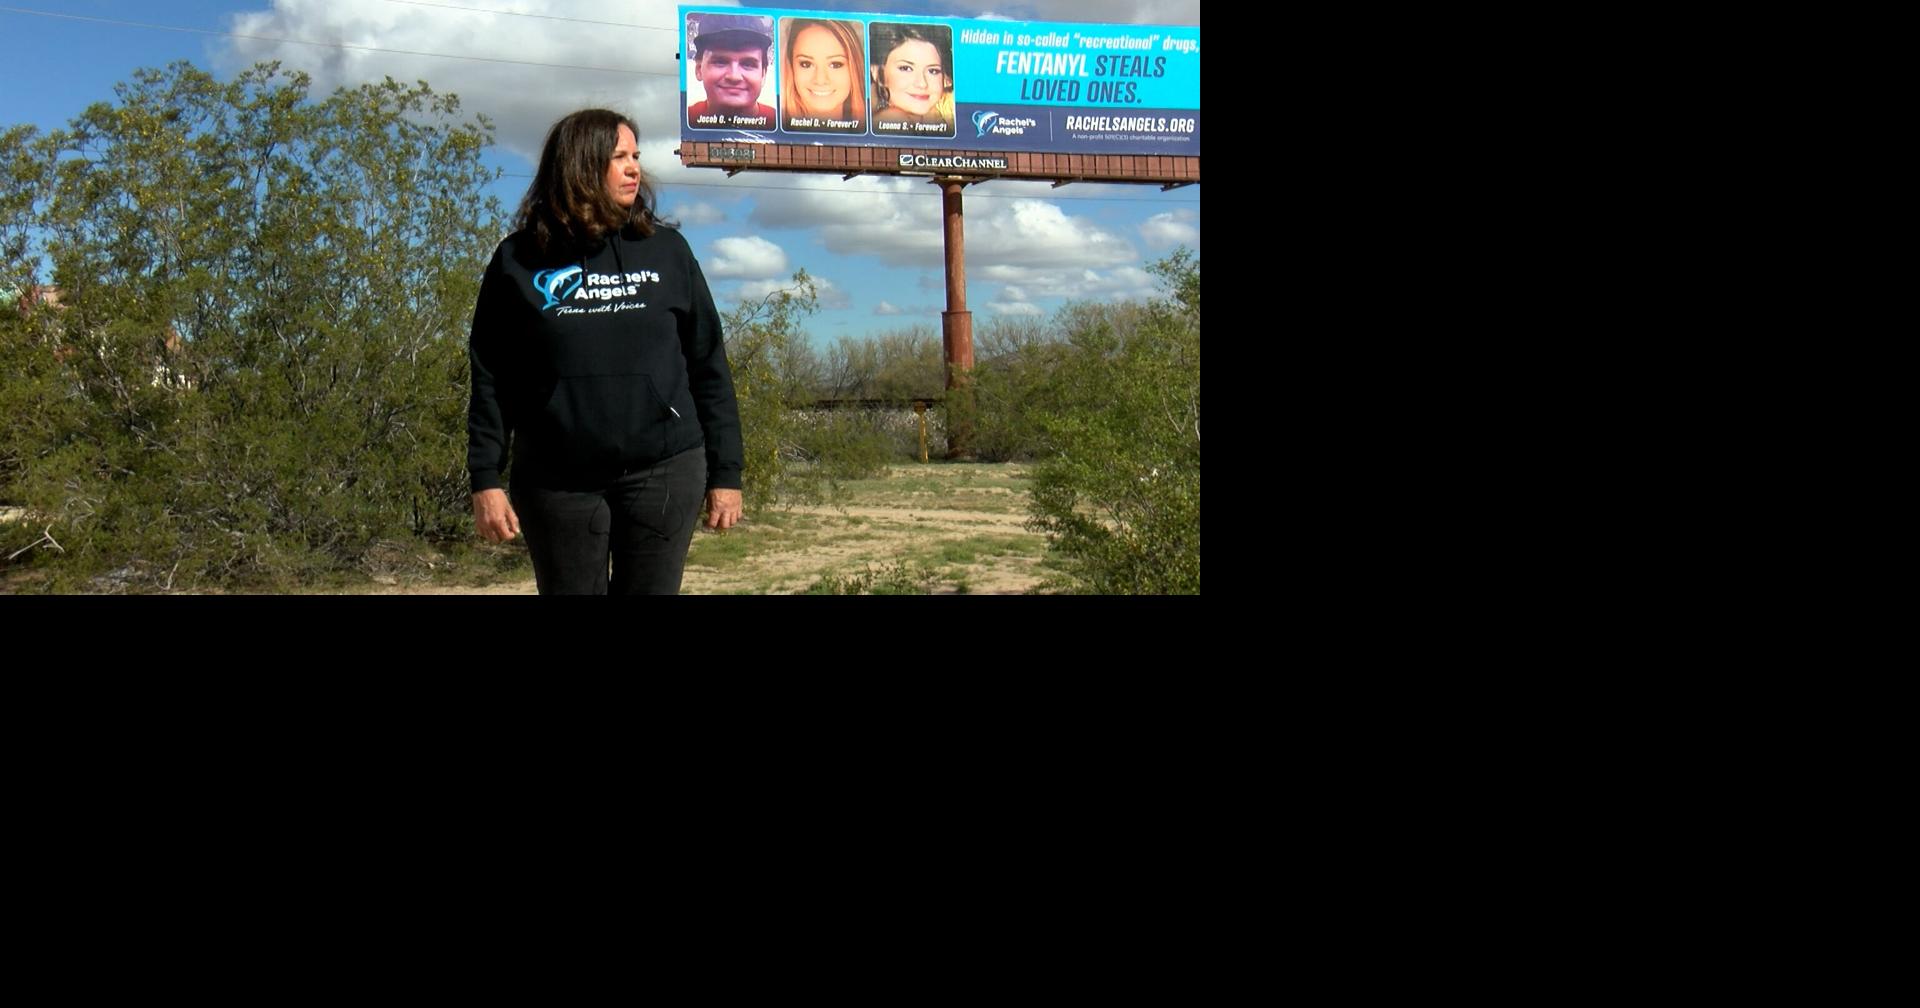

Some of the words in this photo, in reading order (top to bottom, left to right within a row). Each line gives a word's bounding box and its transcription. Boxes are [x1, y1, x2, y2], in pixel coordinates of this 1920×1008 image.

[960, 28, 1000, 45] Hidden
[1003, 31, 1013, 45] in
[1017, 32, 1070, 48] so-called
[1163, 35, 1200, 53] drugs,
[996, 51, 1089, 77] FENTANYL
[1094, 55, 1167, 78] STEALS
[1020, 78, 1080, 102] LOVED
[1086, 81, 1142, 104] ONES.
[696, 114, 718, 124] Jacob
[790, 117, 813, 127] Rachel
[813, 119, 821, 128] D.
[826, 119, 859, 129] Forever17
[998, 117, 1037, 127] Rachel's
[1066, 115, 1195, 133] RACHELSANGELS.ORG
[902, 122, 909, 130] S.
[914, 123, 947, 132] Forever21
[587, 270, 660, 286] Rachel's
[588, 303, 612, 313] with
[613, 301, 646, 313] Voices
